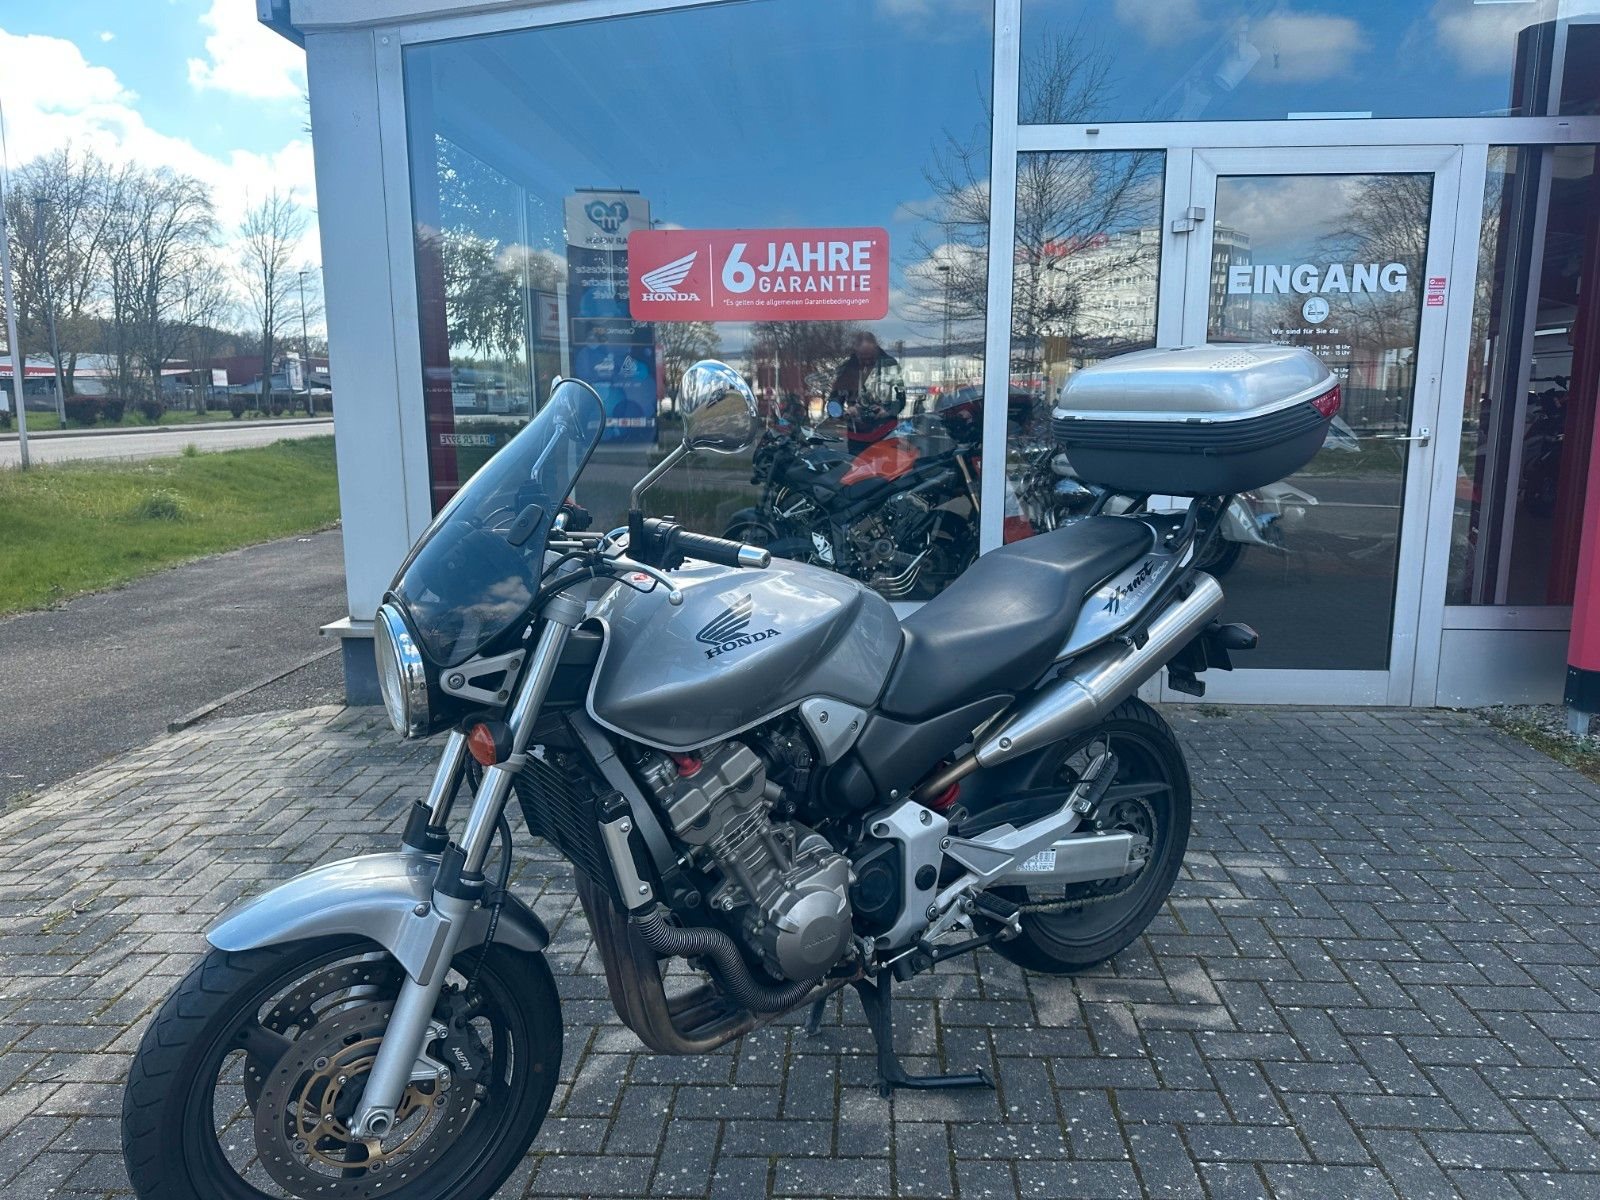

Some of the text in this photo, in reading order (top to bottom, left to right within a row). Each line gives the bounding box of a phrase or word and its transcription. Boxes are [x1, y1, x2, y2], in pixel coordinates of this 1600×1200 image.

[721, 243, 756, 293] 6
[1227, 262, 1408, 294] EINGANG
[758, 275, 871, 293] GARANTIE
[641, 292, 701, 302] HONDA
[1303, 327, 1313, 335] für
[704, 628, 782, 660] HONDA
